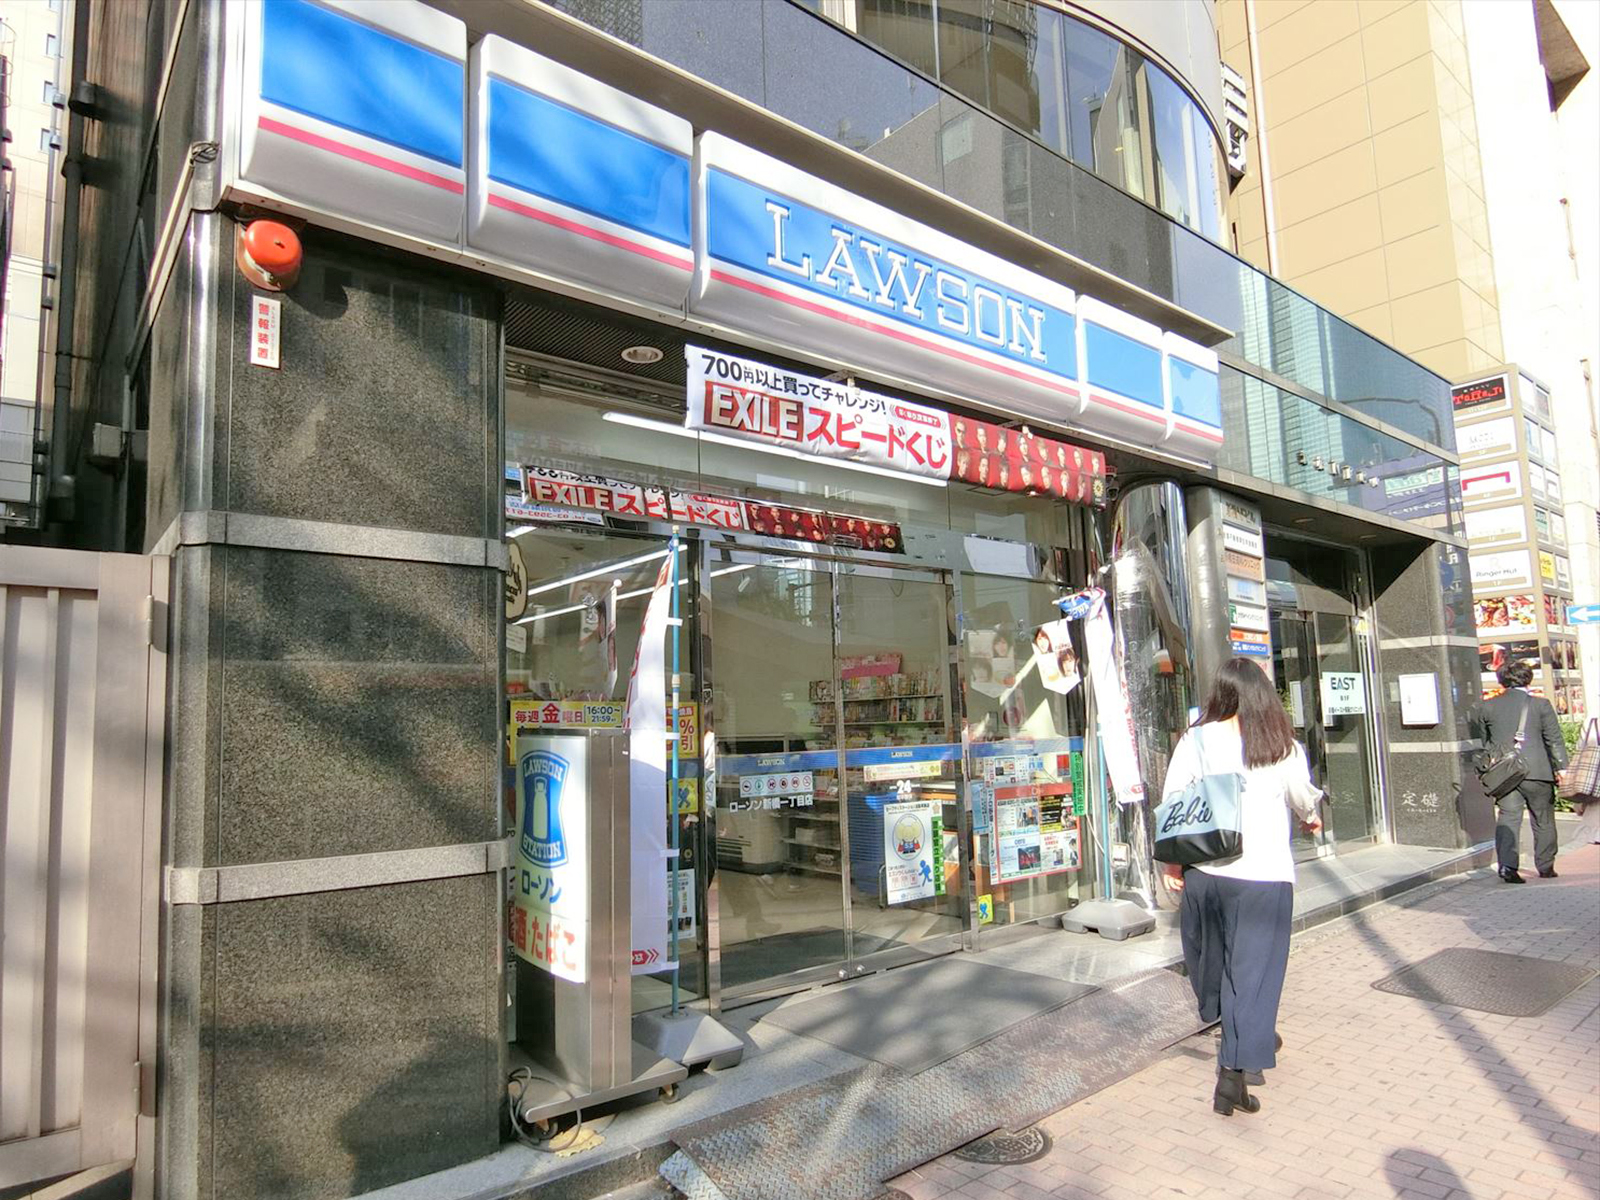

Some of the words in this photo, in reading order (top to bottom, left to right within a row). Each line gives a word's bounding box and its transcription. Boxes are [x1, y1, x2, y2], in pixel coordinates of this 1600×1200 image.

[765, 199, 1048, 364] LAWSON
[709, 387, 800, 440] EXILE
[806, 408, 949, 470] スピードくじ
[534, 480, 611, 511] EXILE
[1331, 677, 1356, 690] EAST
[515, 702, 583, 724] 毎週金曜日
[524, 758, 564, 782] LAWSON
[897, 780, 912, 794] 24
[1401, 790, 1440, 808] 定礎
[729, 794, 814, 813] ローソン新橋一丁目店
[522, 833, 561, 859] STATION
[521, 869, 562, 904] ローソン
